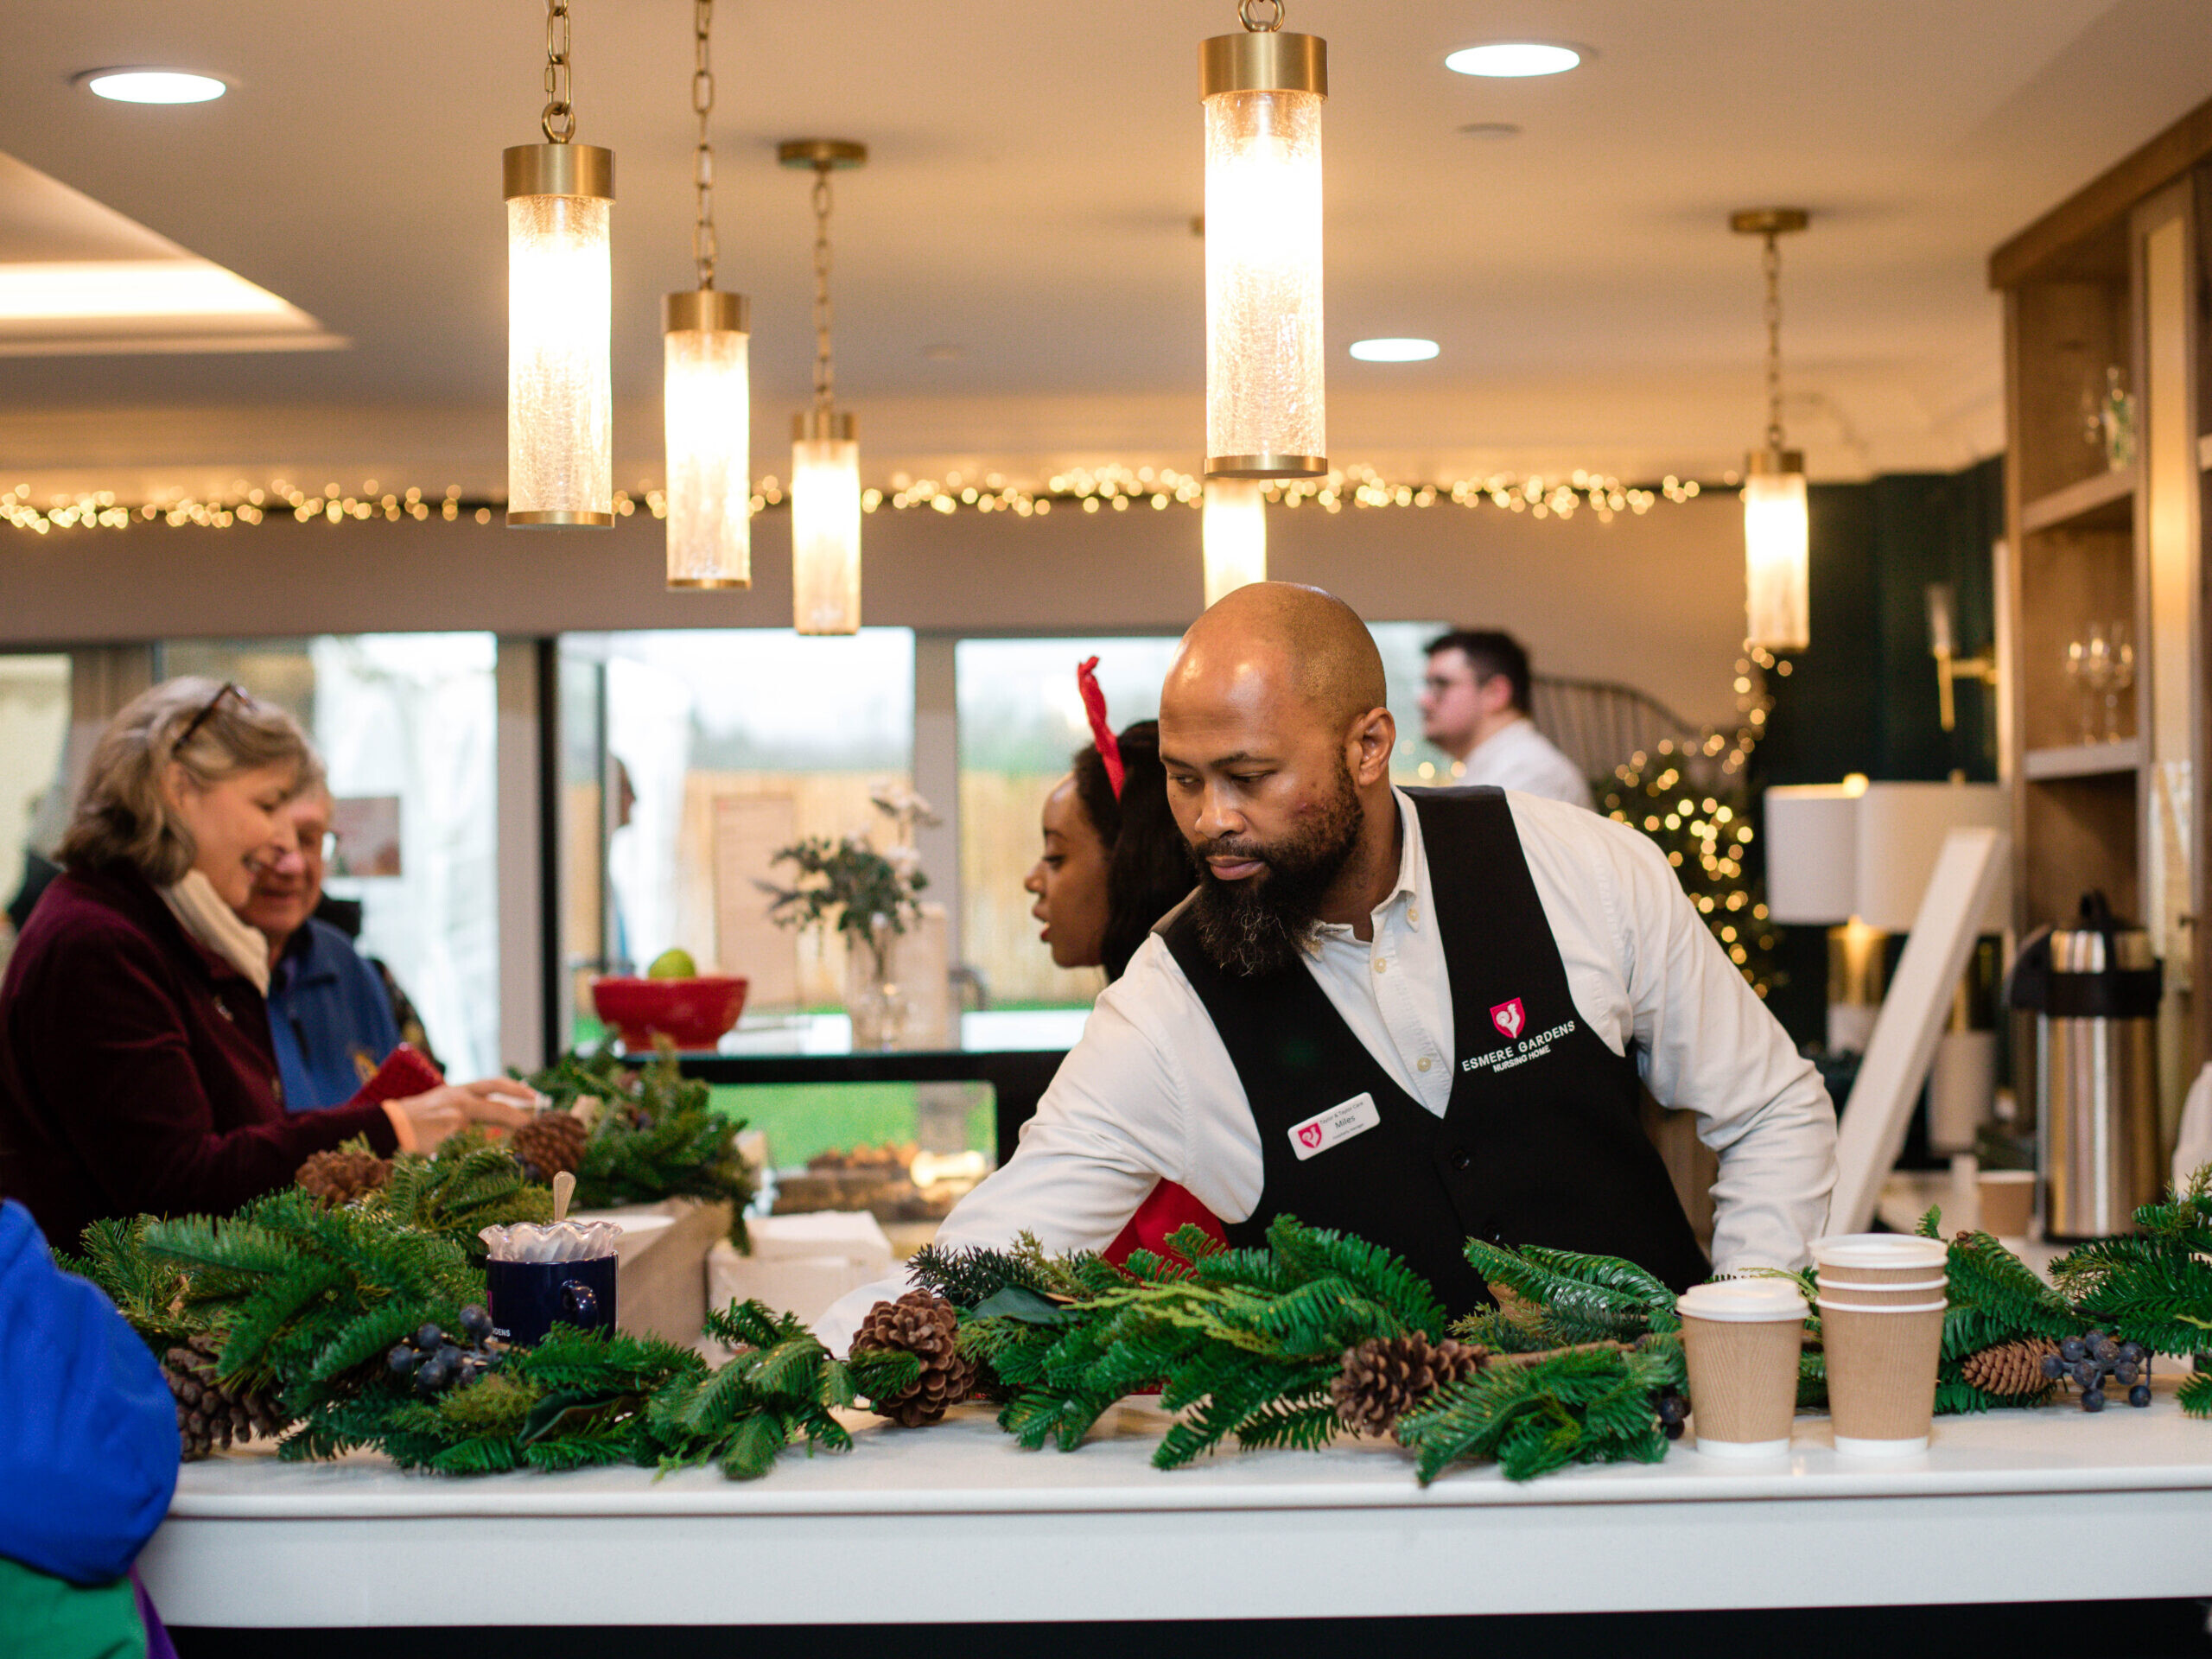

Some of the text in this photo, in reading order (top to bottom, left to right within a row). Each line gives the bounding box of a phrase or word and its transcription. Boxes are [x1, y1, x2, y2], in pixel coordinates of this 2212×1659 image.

[1462, 1020, 1575, 1071] ESMERE GARDENS
[1493, 1045, 1551, 1073] NURSING HOME
[1335, 1116, 1356, 1128] Miles
